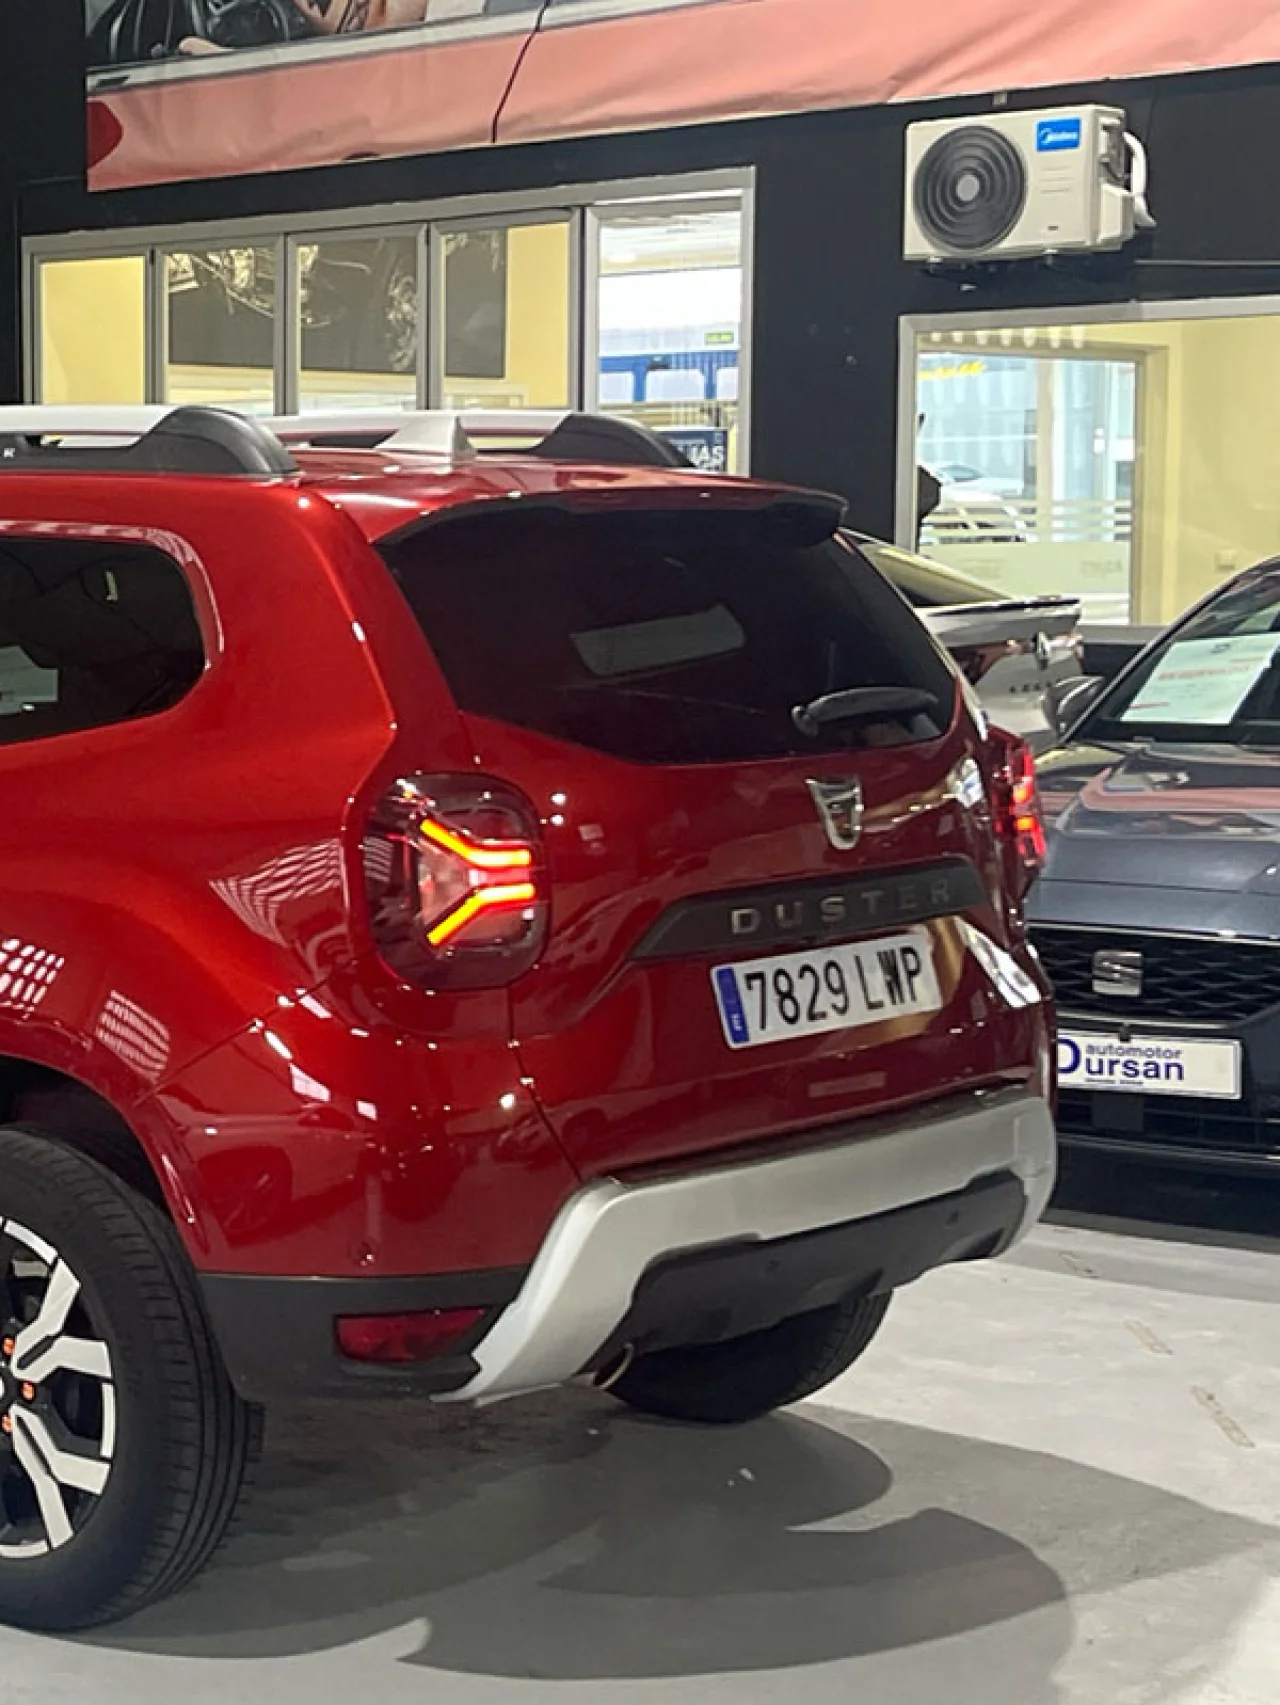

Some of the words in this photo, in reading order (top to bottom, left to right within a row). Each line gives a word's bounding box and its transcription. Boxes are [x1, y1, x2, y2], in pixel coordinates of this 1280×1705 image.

[730, 878, 951, 935] DUSTER
[744, 959, 849, 1031] 7829
[854, 945, 921, 1010] LWP
[1085, 1043, 1182, 1059] automotor
